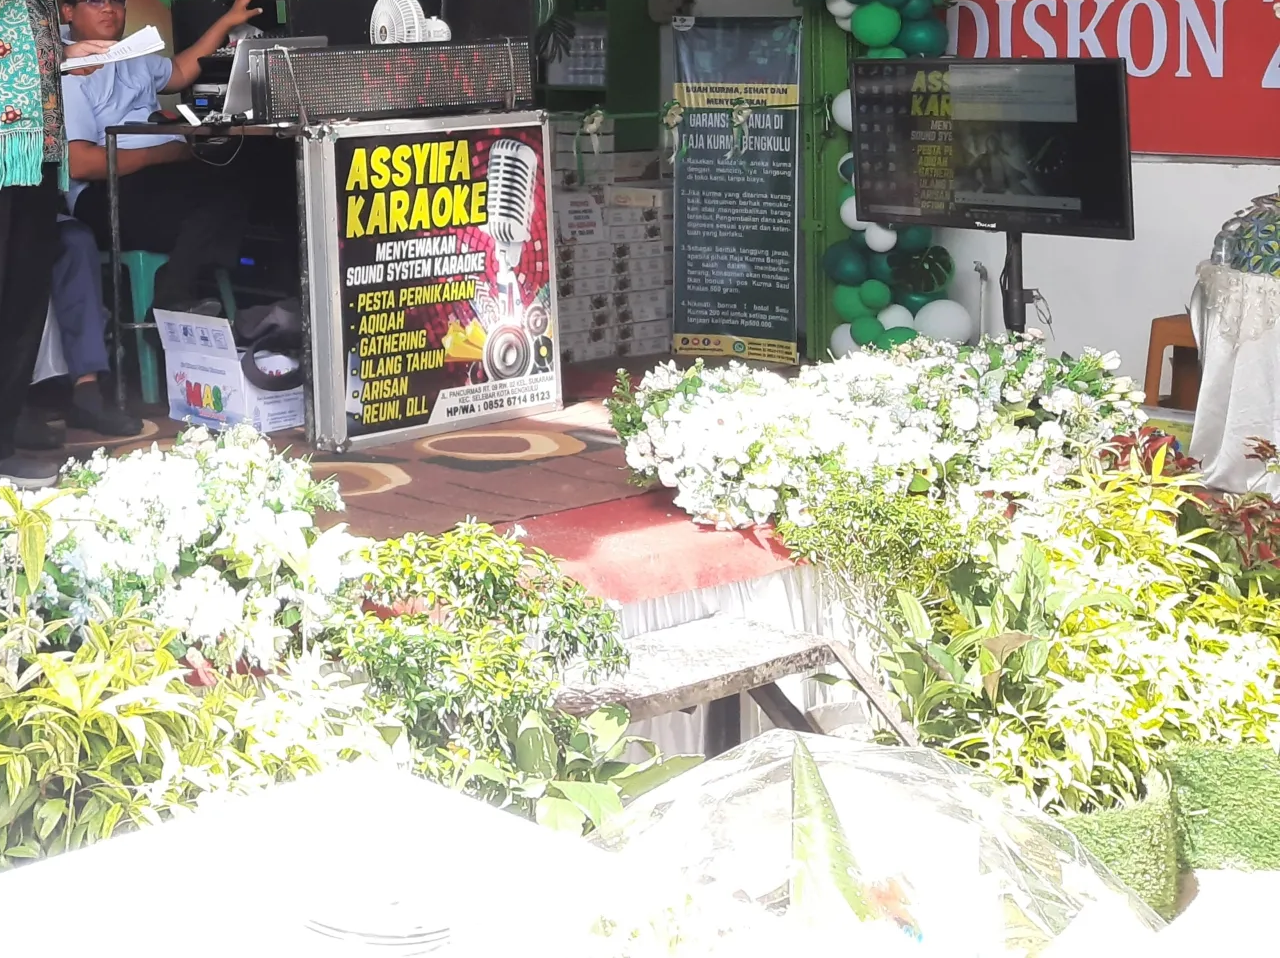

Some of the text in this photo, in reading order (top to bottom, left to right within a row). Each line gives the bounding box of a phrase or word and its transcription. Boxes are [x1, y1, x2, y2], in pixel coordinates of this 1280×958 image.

[709, 86, 742, 95] KURMA,
[744, 87, 769, 95] SEHAT
[774, 114, 783, 130] DI
[707, 135, 733, 150] KURM
[345, 140, 470, 191] ASSYIFA
[346, 182, 487, 239] KARAOKE
[375, 235, 456, 262] MENYEWAKAN
[346, 252, 486, 287] SOUND SYSTEM KARAOKE
[357, 280, 476, 313] PESTA PERNIKAHAN
[358, 310, 405, 335] AQIQAH
[359, 329, 427, 357] GATHERING
[360, 348, 444, 380] ULANG TAHUN
[362, 376, 409, 402] ARISAN
[459, 396, 471, 404] KEC.
[472, 392, 496, 402] SELEBAR
[496, 389, 511, 398] KOTA
[482, 384, 491, 393] RT.
[498, 382, 508, 390] RW.
[362, 395, 429, 425] REUNI, DLL
[446, 390, 550, 417] HP/WA 0852 6714 8123
